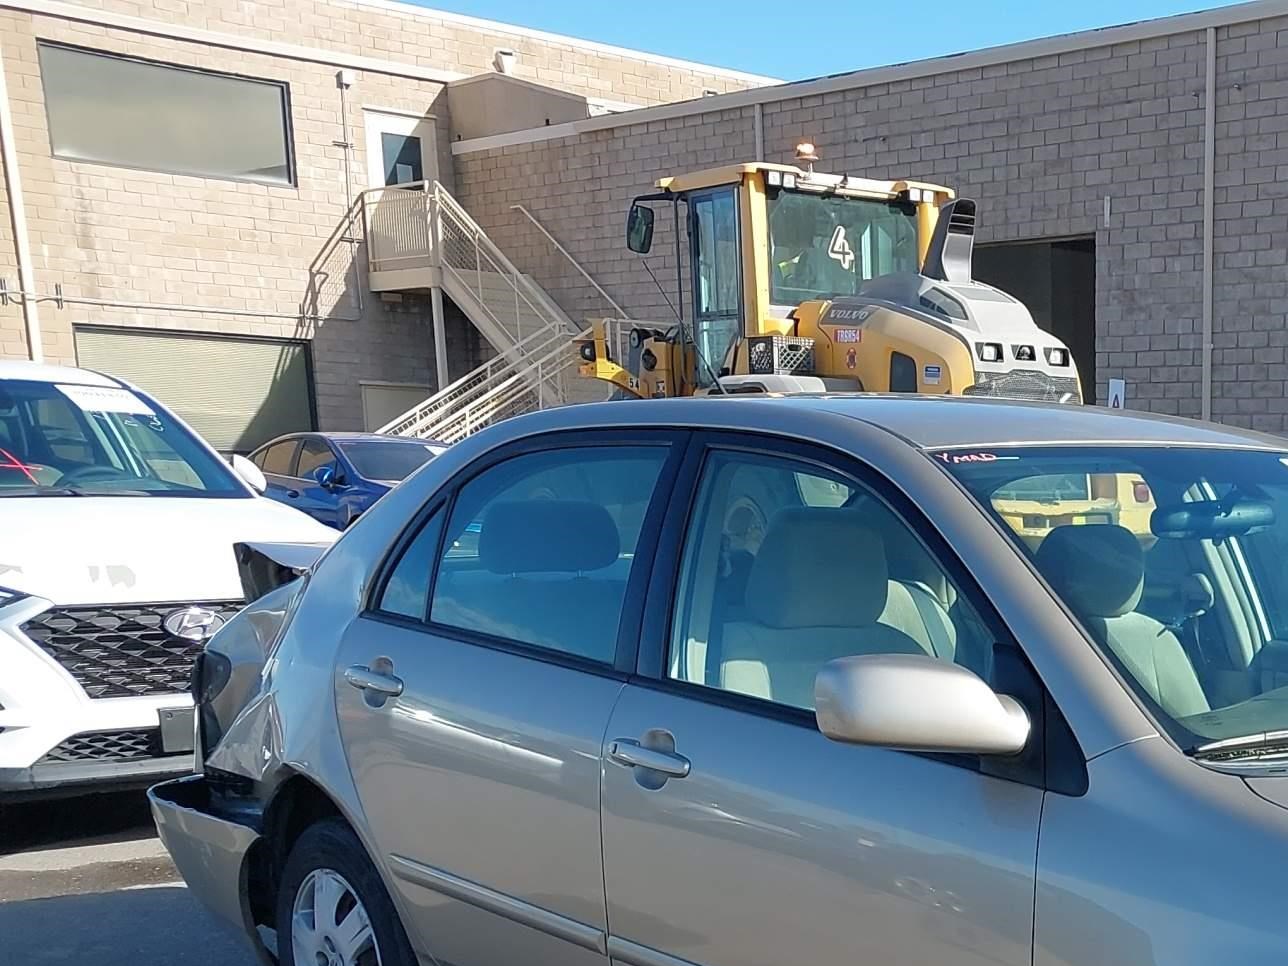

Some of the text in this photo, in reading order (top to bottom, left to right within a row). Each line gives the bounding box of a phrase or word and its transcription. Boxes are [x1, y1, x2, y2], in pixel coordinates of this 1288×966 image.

[828, 225, 855, 270] 4
[829, 309, 869, 320] VOLVO
[1112, 393, 1120, 408] A
